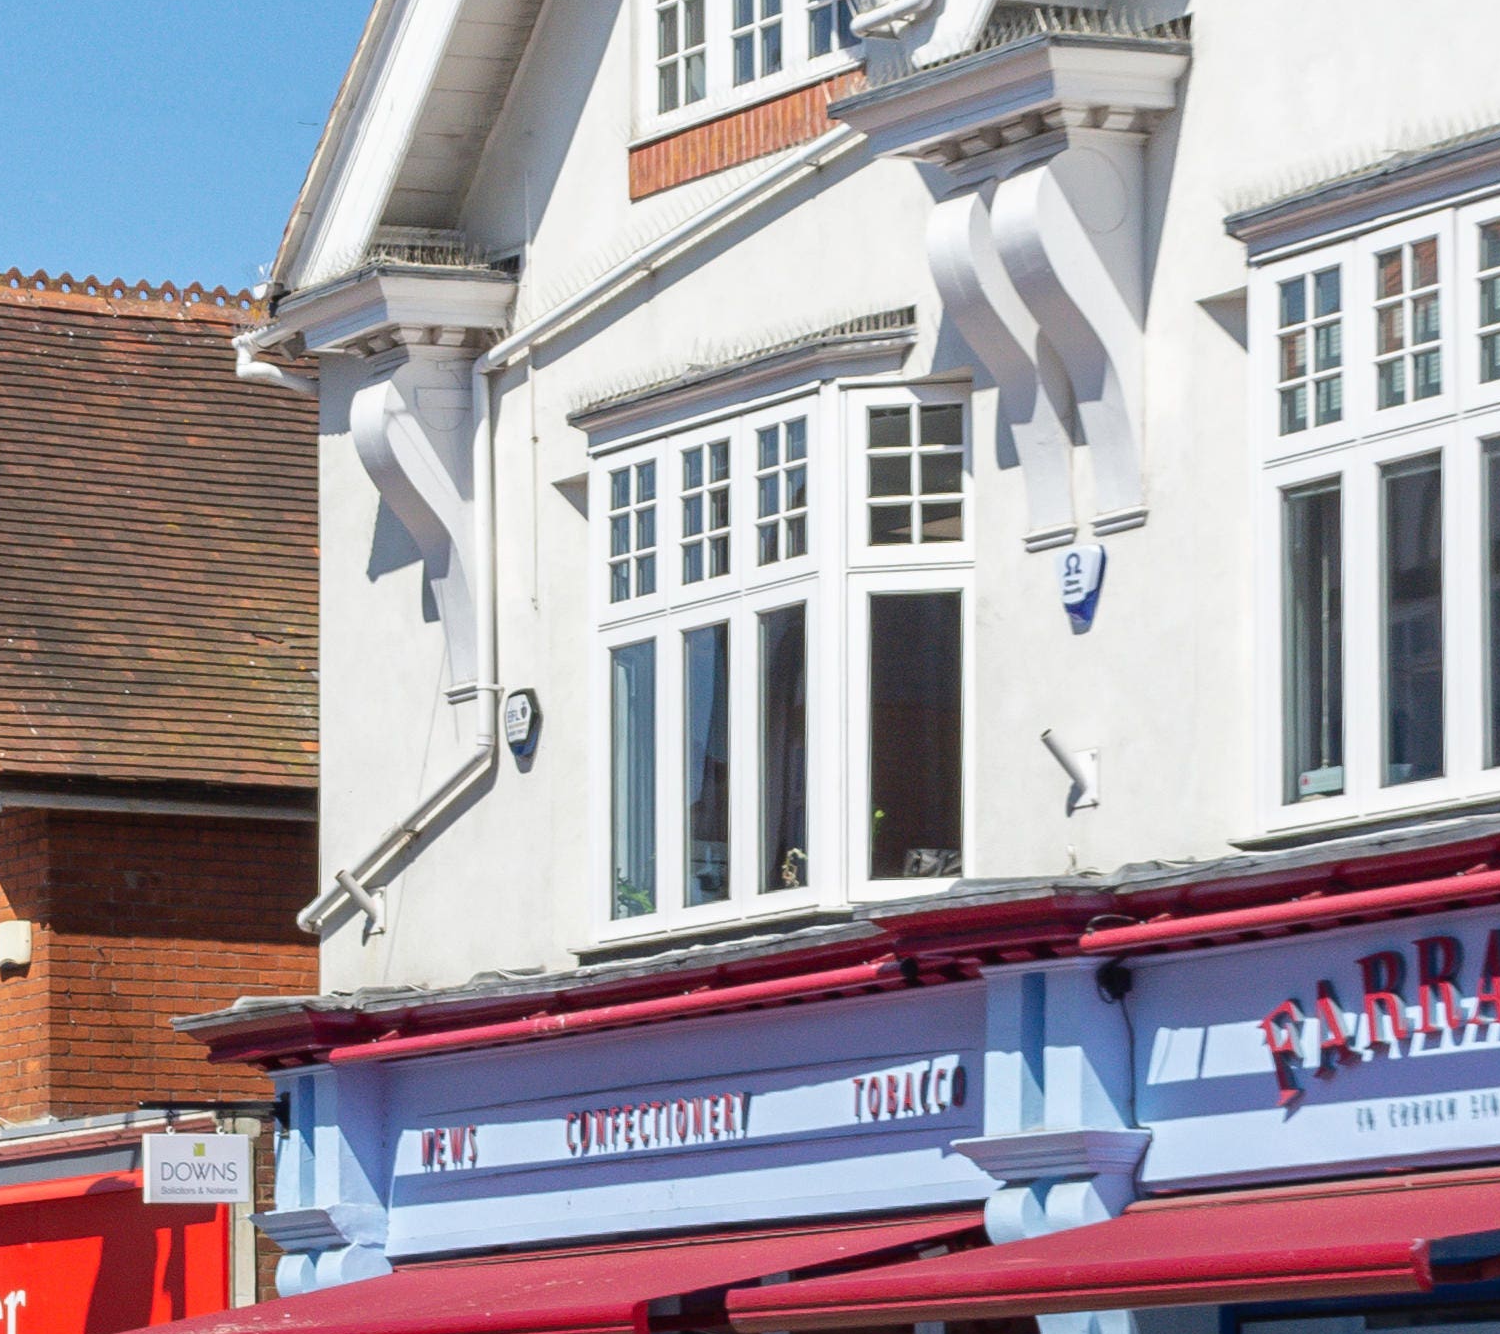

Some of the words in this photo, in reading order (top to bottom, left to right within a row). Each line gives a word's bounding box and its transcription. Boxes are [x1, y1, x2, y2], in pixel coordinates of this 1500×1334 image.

[421, 1125, 479, 1172] NEWS
[567, 1092, 750, 1155] CONFECTIONERY
[853, 1065, 967, 1123] TOBACCO
[160, 1161, 238, 1182] DOWNS
